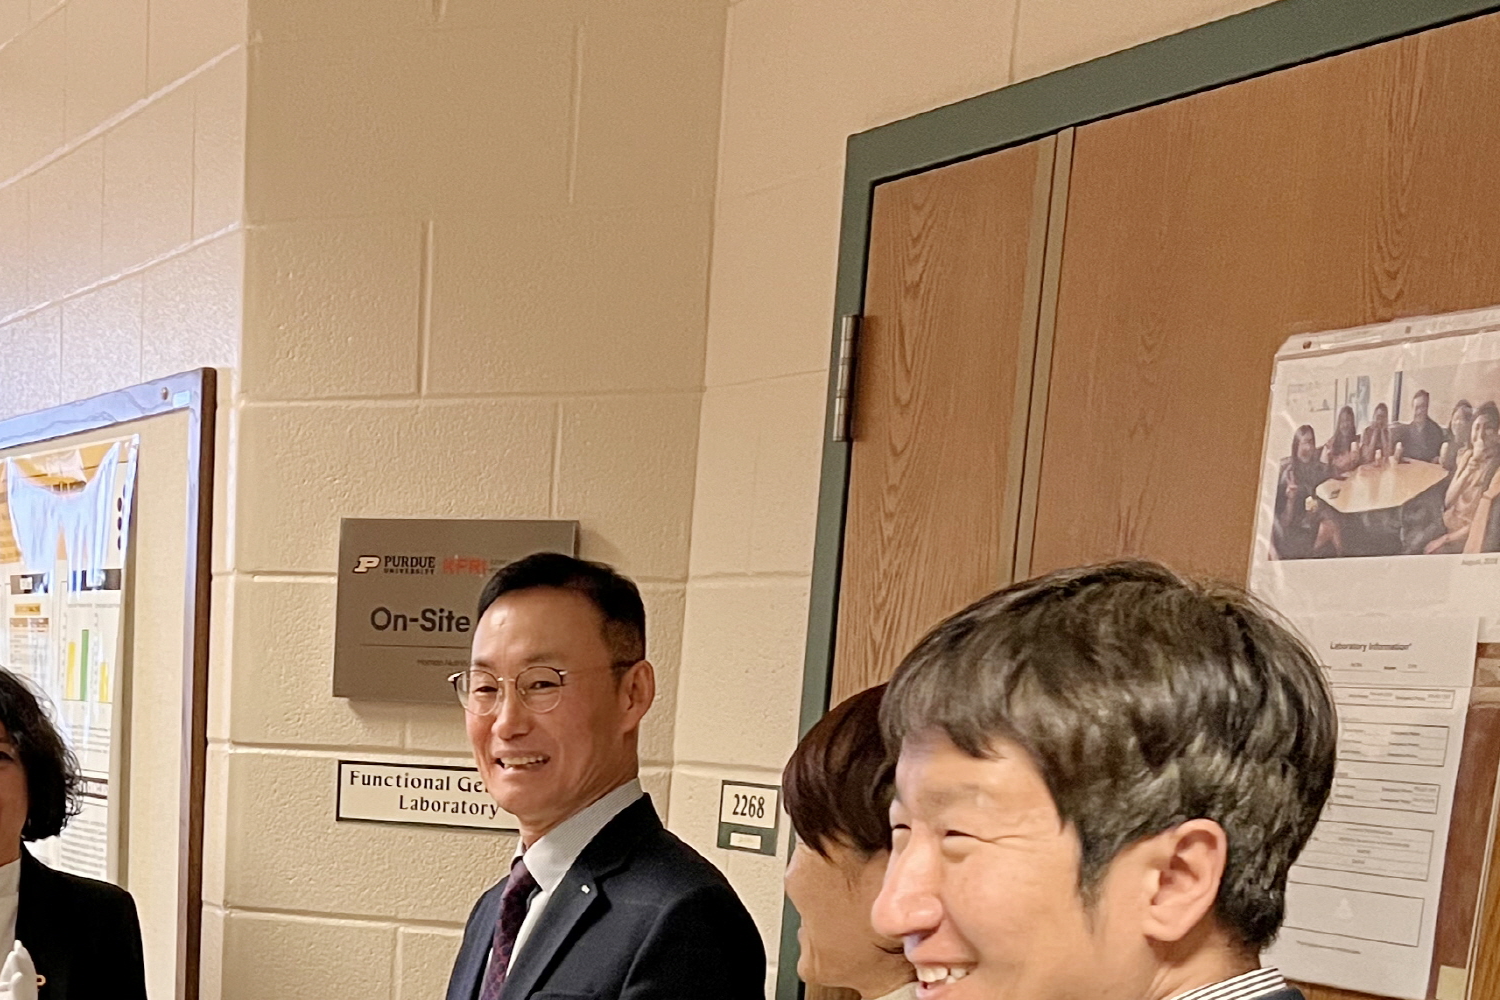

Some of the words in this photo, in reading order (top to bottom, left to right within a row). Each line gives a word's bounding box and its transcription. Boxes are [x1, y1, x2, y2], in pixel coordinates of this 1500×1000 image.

[384, 556, 436, 568] PURDUE
[370, 606, 471, 633] On-Site
[350, 770, 450, 791] Functional
[399, 795, 499, 820] Laboratory
[732, 793, 765, 819] 2268
